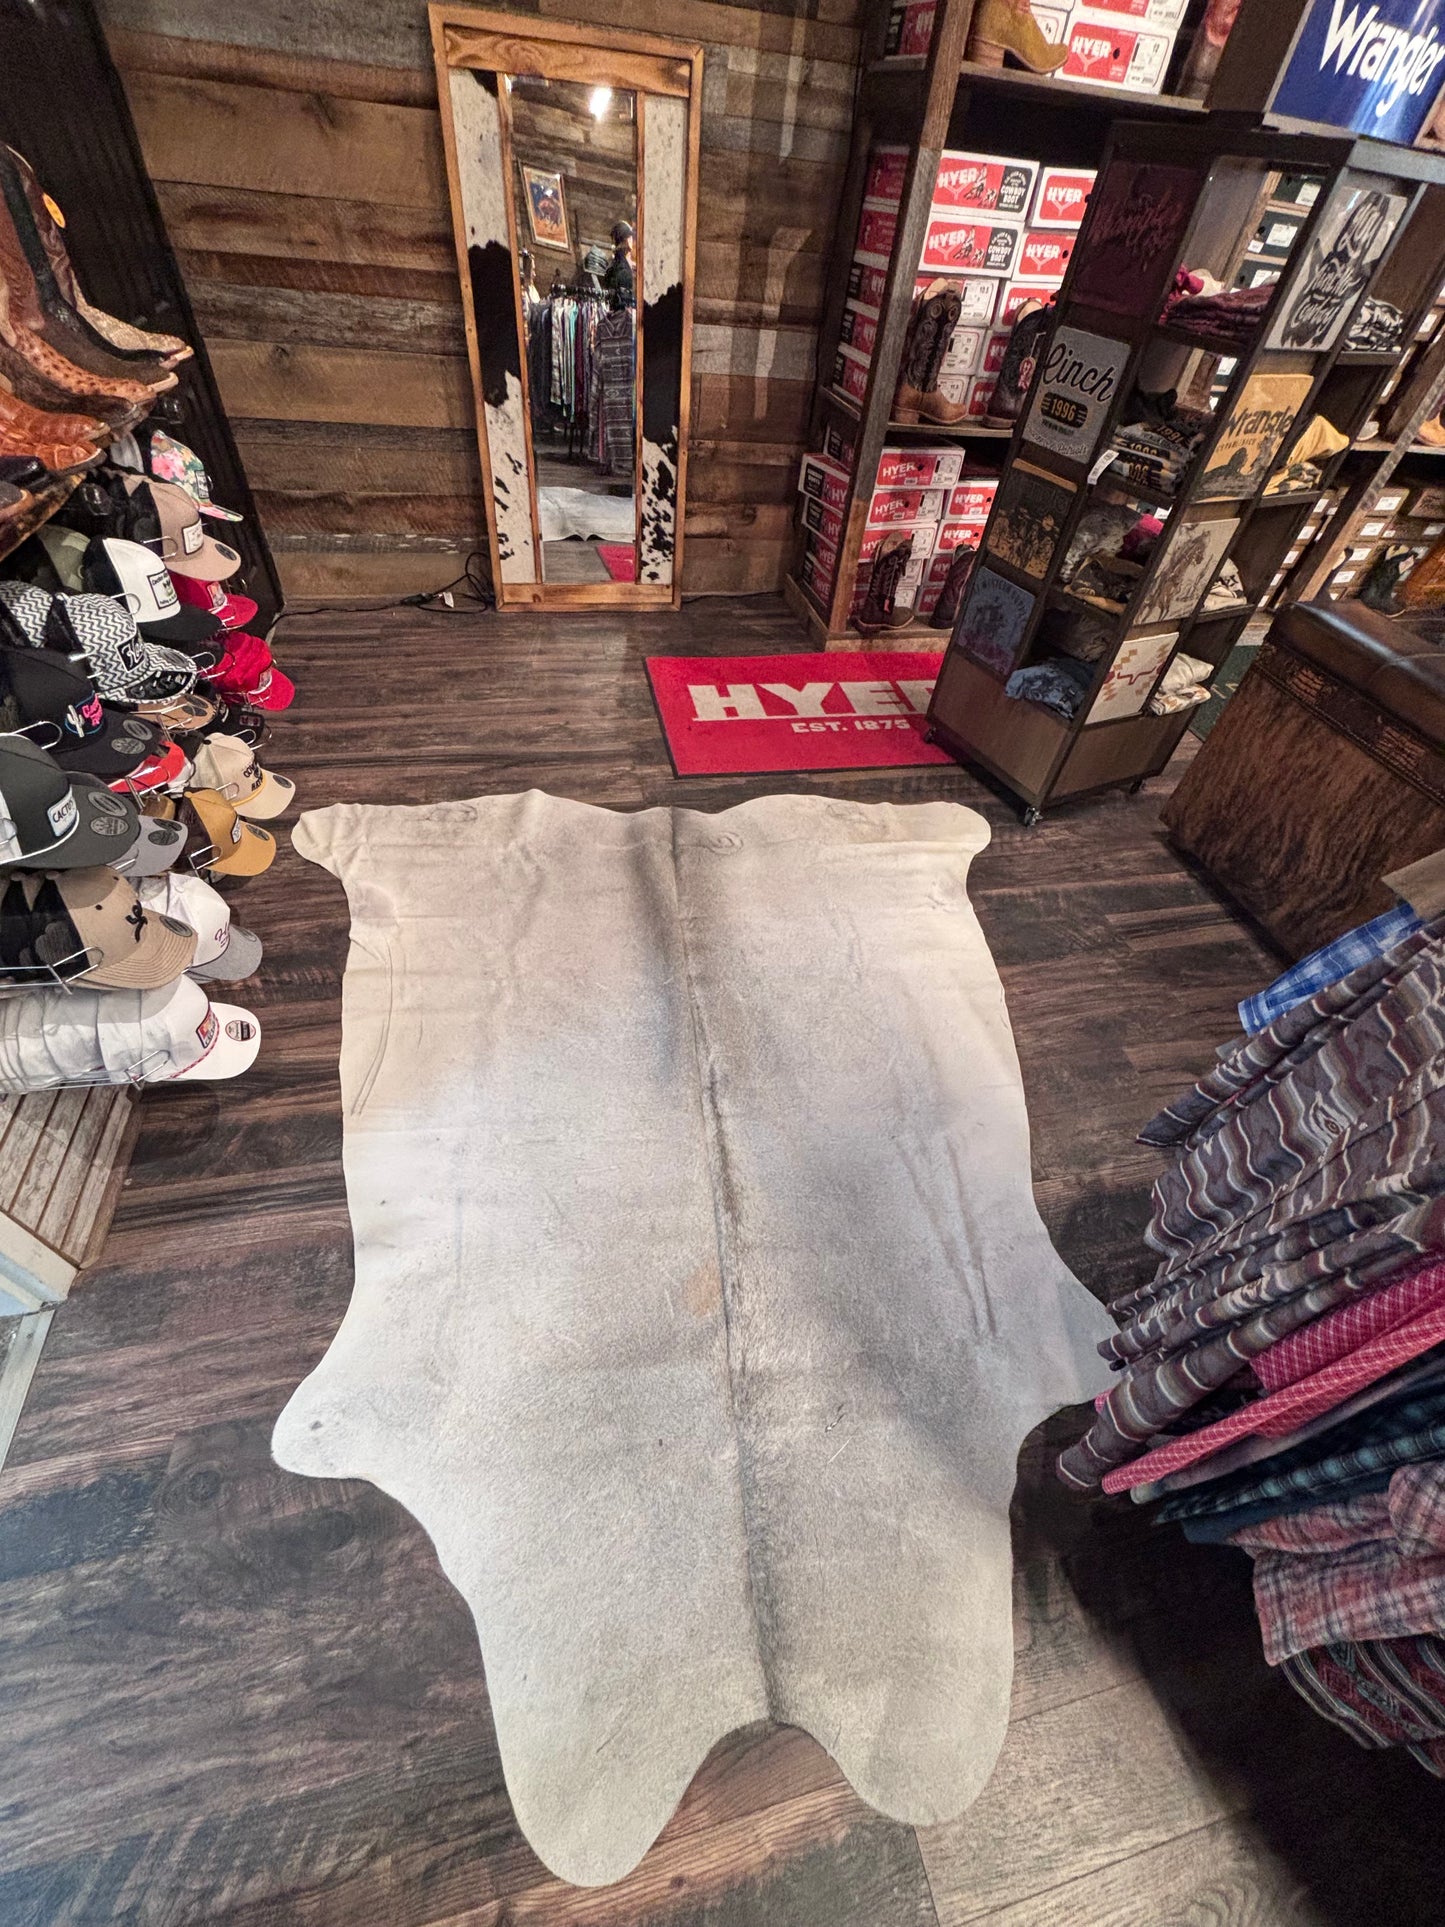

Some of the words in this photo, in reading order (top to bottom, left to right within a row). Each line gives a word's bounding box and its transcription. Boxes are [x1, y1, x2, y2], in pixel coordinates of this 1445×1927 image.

[1070, 35, 1113, 59] HYER
[1318, 0, 1445, 118] Wrangler
[936, 167, 978, 188] HYER
[1046, 186, 1084, 203] HYER
[928, 229, 968, 249] HYER
[1025, 243, 1061, 259] HYER
[1050, 398, 1078, 422] 1996
[882, 462, 917, 478] HYER
[954, 493, 984, 505] HYER
[874, 500, 905, 516] HYER
[943, 528, 973, 540] HYER
[791, 721, 848, 734] EST.
[854, 718, 911, 732] 1875
